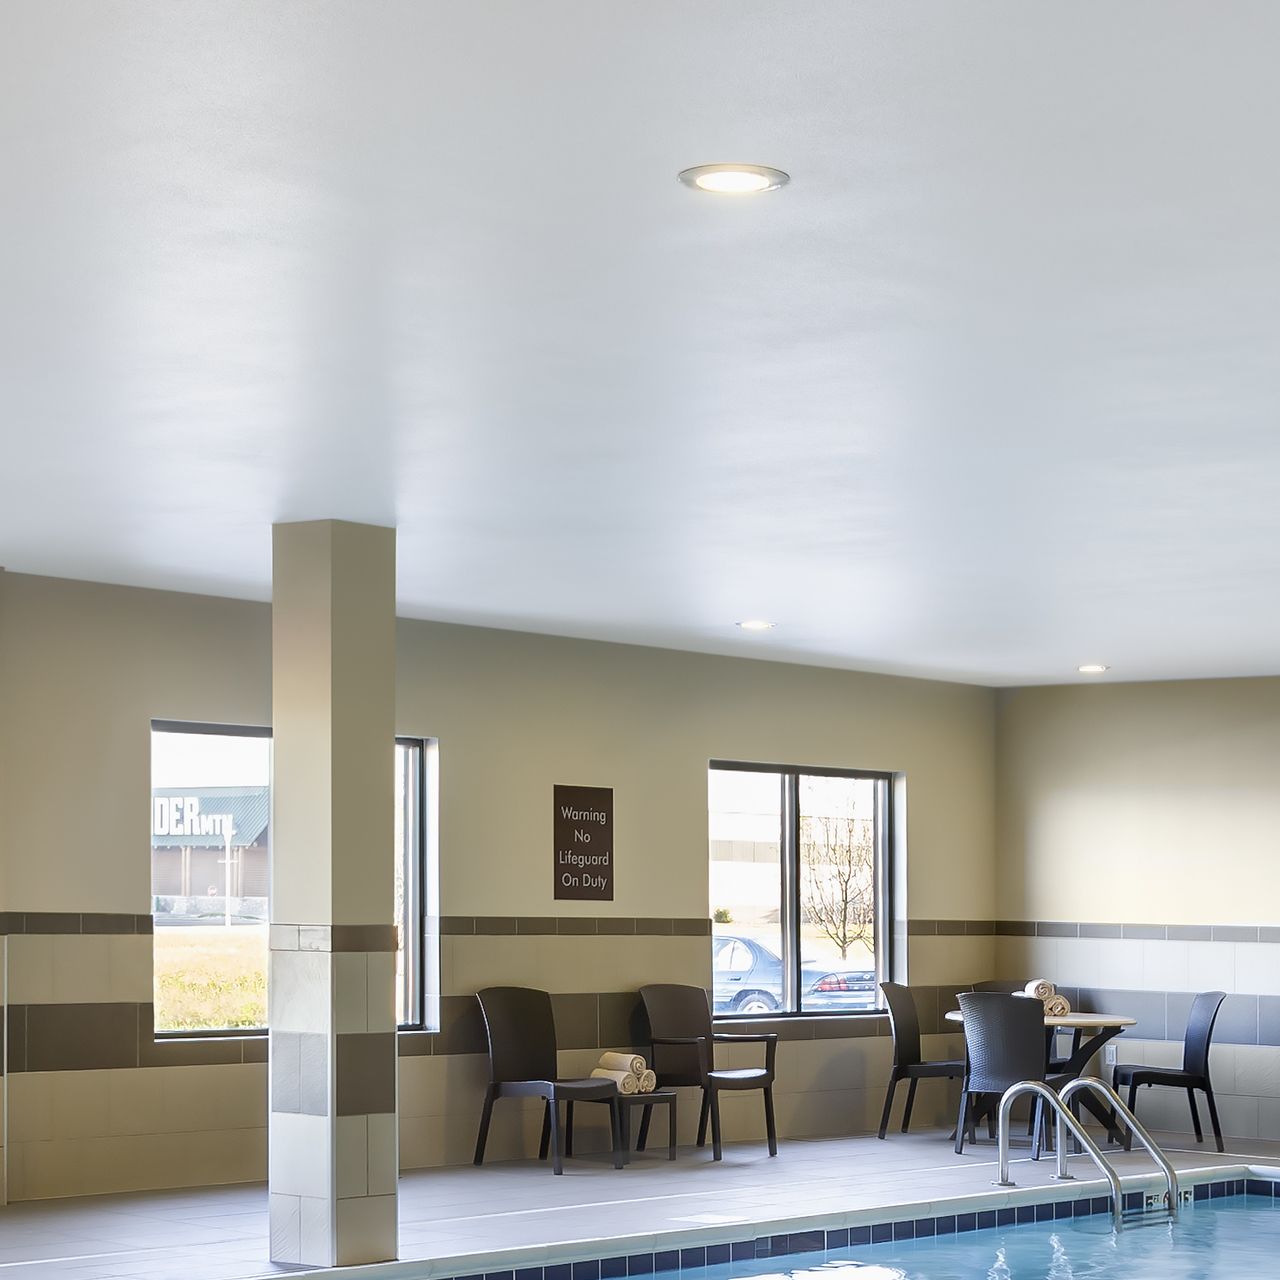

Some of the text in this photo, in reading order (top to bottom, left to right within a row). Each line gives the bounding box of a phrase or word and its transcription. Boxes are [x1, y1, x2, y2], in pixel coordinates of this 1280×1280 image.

[561, 806, 607, 825] Warning
[574, 829, 591, 843] No
[559, 849, 609, 868] Lifeguard
[561, 872, 608, 891] On Duty
